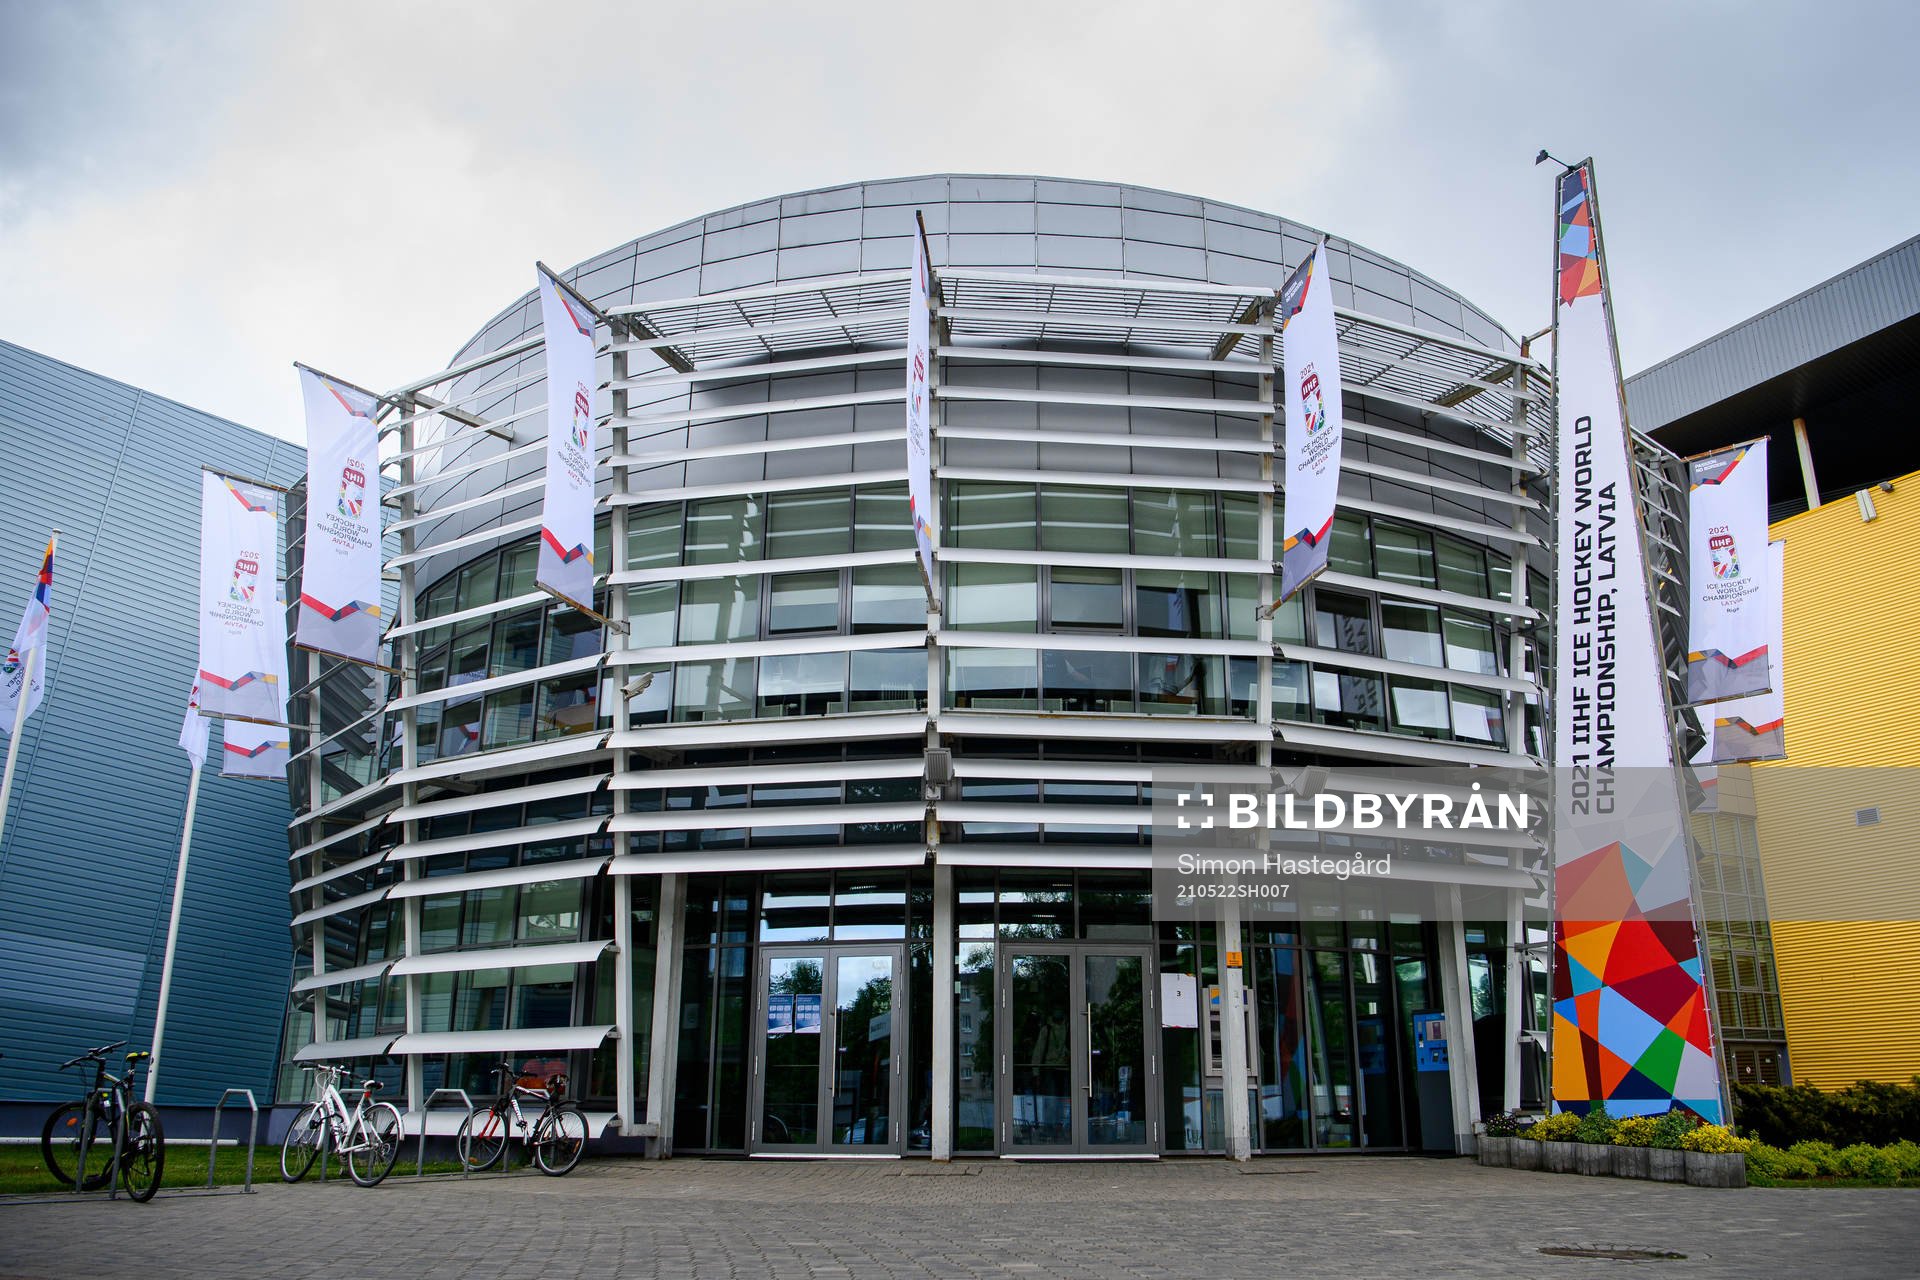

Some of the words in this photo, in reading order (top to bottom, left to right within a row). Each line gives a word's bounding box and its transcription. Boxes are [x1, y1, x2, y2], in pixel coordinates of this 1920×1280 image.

[1300, 362, 1315, 379] 2021
[1302, 377, 1318, 395] IIHF
[1298, 436, 1339, 471] CHAMPIONSHIP
[1301, 441, 1311, 455] ICE
[1312, 425, 1334, 446] HOCKEY
[1308, 438, 1329, 457] WORLD
[1574, 415, 1592, 513] WORLD
[1598, 481, 1616, 581] LATVIA
[1709, 525, 1729, 535] 2021
[1711, 538, 1731, 547] IIHF
[1573, 520, 1592, 625] HOCKEY
[1721, 577, 1752, 589] HOCKEY
[1702, 586, 1759, 602] CHAMPIONSHIP
[1717, 585, 1744, 595] WORLD
[1573, 632, 1591, 678] ICE
[1572, 686, 1590, 745] IIHF
[1597, 588, 1618, 814] CHAMPIONSHIP,
[1572, 754, 1589, 815] 2021
